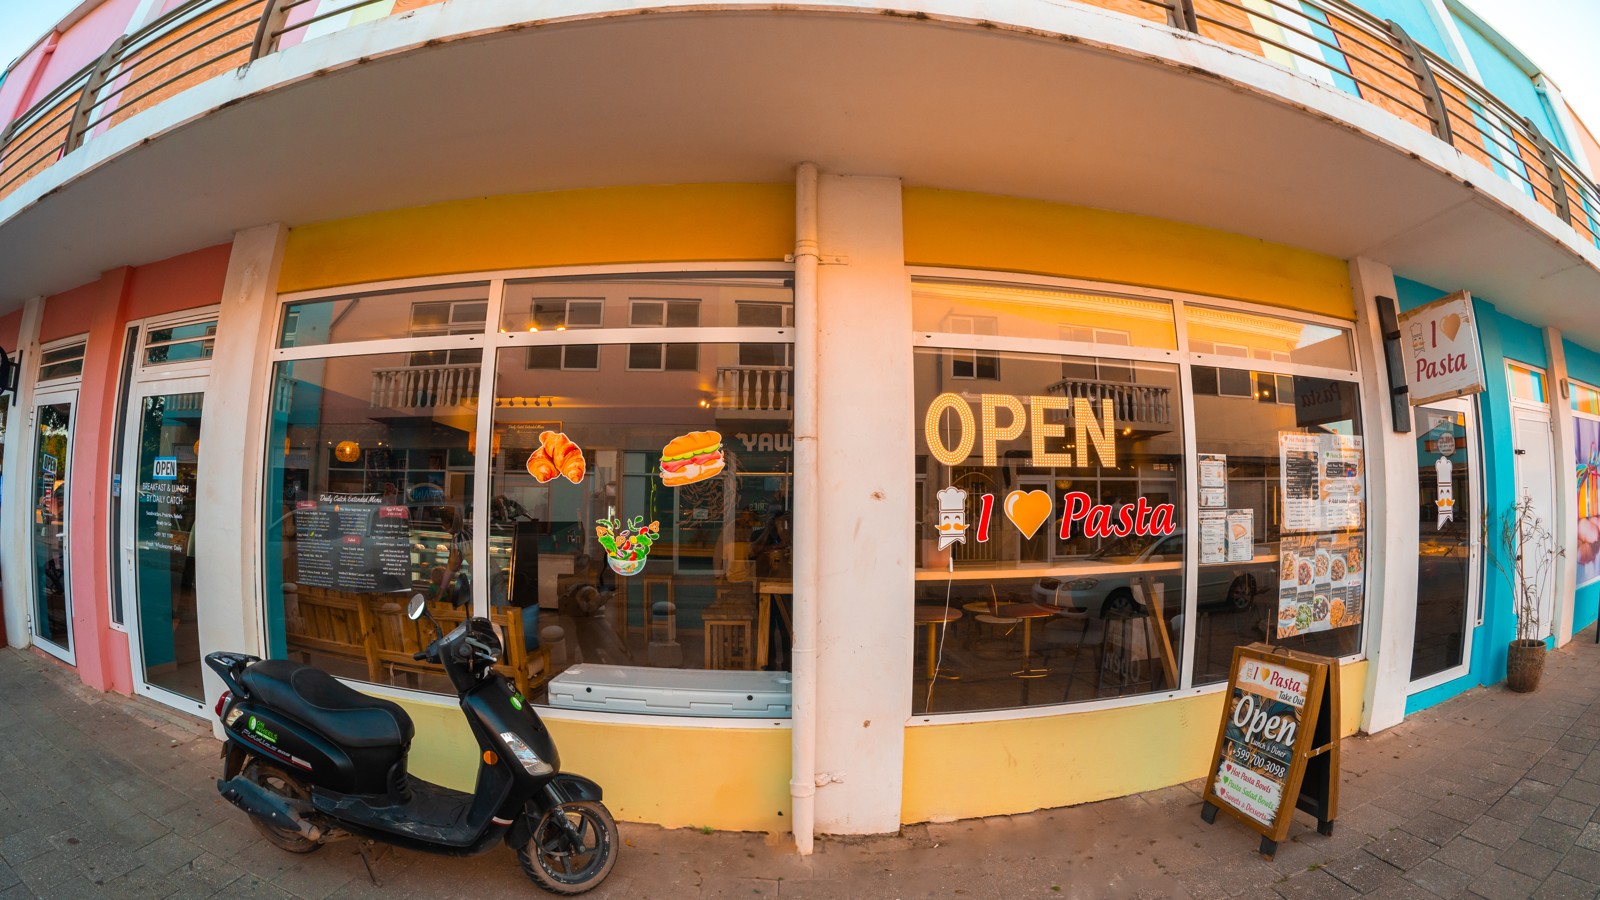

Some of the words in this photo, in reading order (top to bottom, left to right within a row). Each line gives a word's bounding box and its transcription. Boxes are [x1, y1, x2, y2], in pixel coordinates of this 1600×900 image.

[1430, 320, 1437, 348] I
[1416, 353, 1467, 382] Pasta
[925, 392, 1116, 467] OPEN
[155, 461, 175, 476] OPEN
[142, 482, 166, 492] BREAKFAST
[171, 484, 189, 493] LUNCH
[153, 495, 166, 504] DAILY
[166, 495, 183, 505] CATCH
[976, 493, 995, 543] I
[1059, 491, 1176, 540] Pasta
[1253, 666, 1259, 680] I
[1270, 671, 1301, 692] Pasta
[1278, 691, 1292, 702] Take
[1292, 695, 1304, 706] Out
[256, 726, 278, 740] WHEELS
[1233, 695, 1296, 747] Open
[1250, 737, 1266, 749] Lunch
[1233, 747, 1250, 761] +599
[1249, 754, 1265, 768] 700
[1264, 761, 1286, 777] 3098
[1231, 766, 1240, 777] Hot
[1241, 772, 1254, 785] Pasta
[1254, 779, 1271, 793] Bowls
[1224, 791, 1241, 806] Sweets
[1245, 803, 1267, 820] Desserts
[1228, 779, 1241, 792] Pasta
[1242, 787, 1258, 800] Salad
[1257, 795, 1274, 809] Bowls
